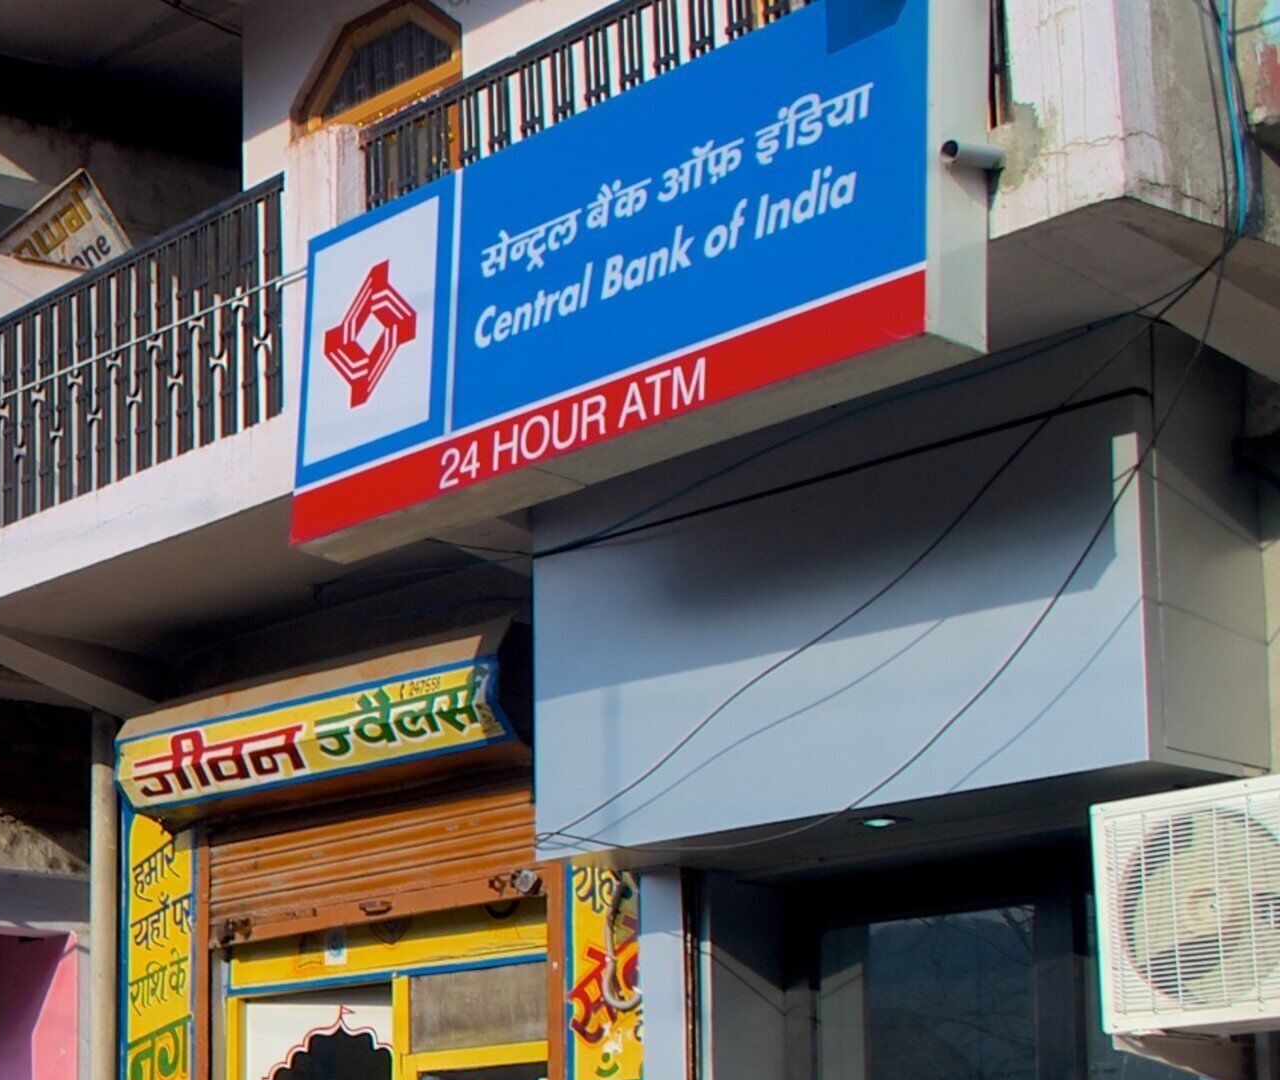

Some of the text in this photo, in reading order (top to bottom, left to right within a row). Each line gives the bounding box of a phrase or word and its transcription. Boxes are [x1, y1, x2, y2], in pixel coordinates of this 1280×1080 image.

[480, 208, 582, 278] सेन्ट्रल
[587, 177, 652, 229] बैंक
[756, 82, 874, 165] इंडिया
[474, 167, 858, 348] Central Bank of India
[439, 357, 708, 489] 24 HOUR ATM
[131, 730, 307, 798] जीवन
[130, 892, 195, 951] यहाँ पर
